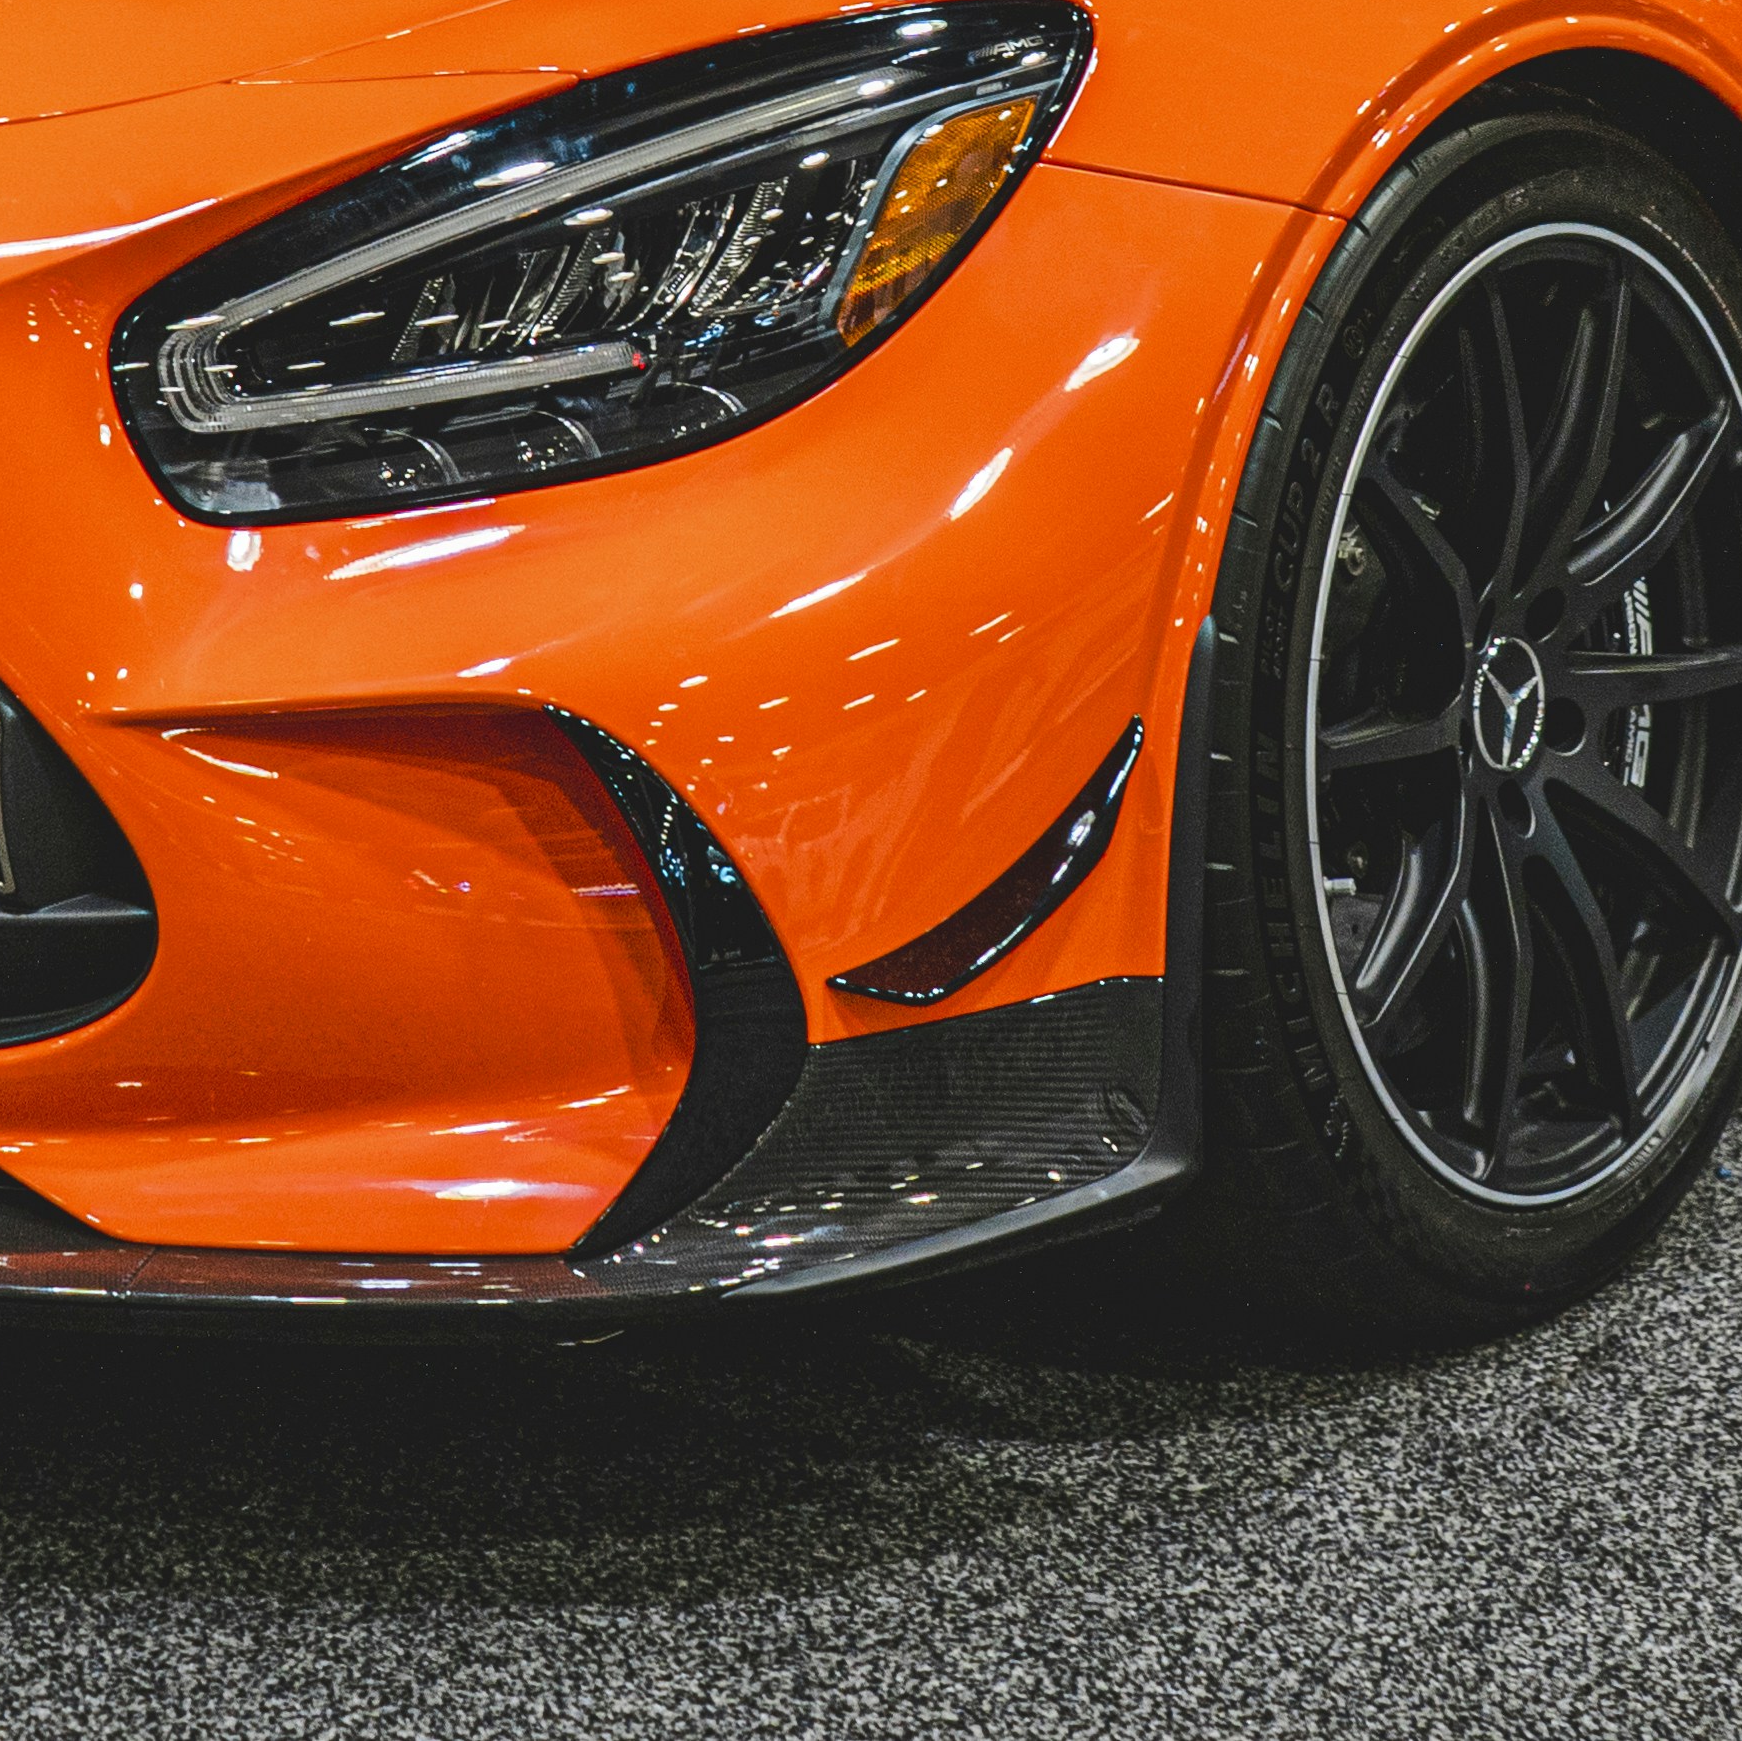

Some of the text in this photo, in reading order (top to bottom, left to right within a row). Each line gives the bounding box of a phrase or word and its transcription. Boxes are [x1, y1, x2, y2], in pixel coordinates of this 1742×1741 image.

[992, 34, 1046, 56] AMG
[1273, 481, 1311, 594] CUP
[1300, 436, 1323, 474] 2
[1314, 381, 1343, 429] R
[1254, 729, 1332, 1094] MICHELIN
